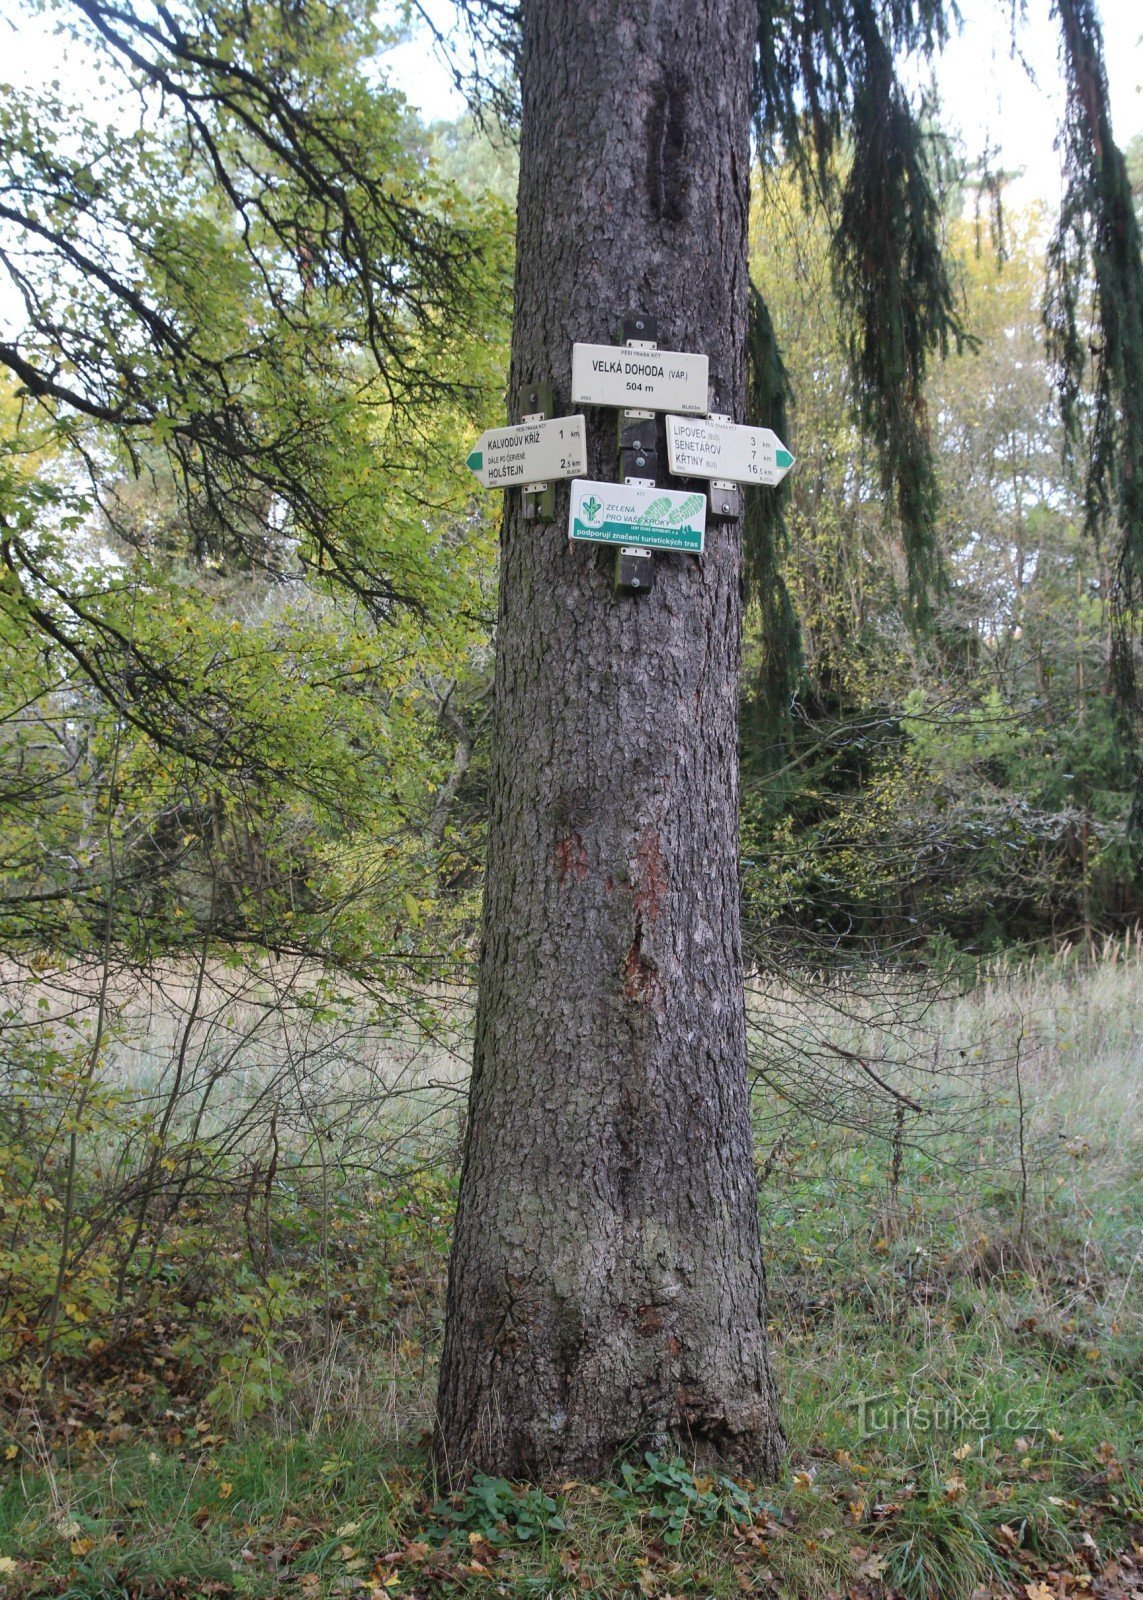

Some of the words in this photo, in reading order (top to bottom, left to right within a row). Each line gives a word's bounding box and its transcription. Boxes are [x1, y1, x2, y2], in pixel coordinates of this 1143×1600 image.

[592, 360, 622, 374] VELKÁ
[625, 363, 664, 378] DOHODA
[626, 382, 642, 391] 504
[560, 430, 564, 439] 1
[571, 430, 580, 438] km
[674, 425, 706, 439] LIPOVEC
[488, 434, 523, 450] KALVODŮV
[524, 430, 540, 445] KŘÍŽ
[674, 439, 721, 454] SENETÁŘOV
[750, 436, 756, 446] 3
[676, 452, 704, 466] KŘTINY
[752, 450, 756, 460] 7
[560, 458, 571, 470] 2,5
[488, 464, 524, 478] HOLŠTEJN
[606, 504, 636, 513] ZELENÁ
[606, 514, 622, 522] PRO
[624, 514, 642, 523] VAŠE
[642, 518, 670, 526] KROKY
[576, 528, 611, 538] podporují
[612, 532, 640, 542] značení
[641, 536, 683, 546] turistických
